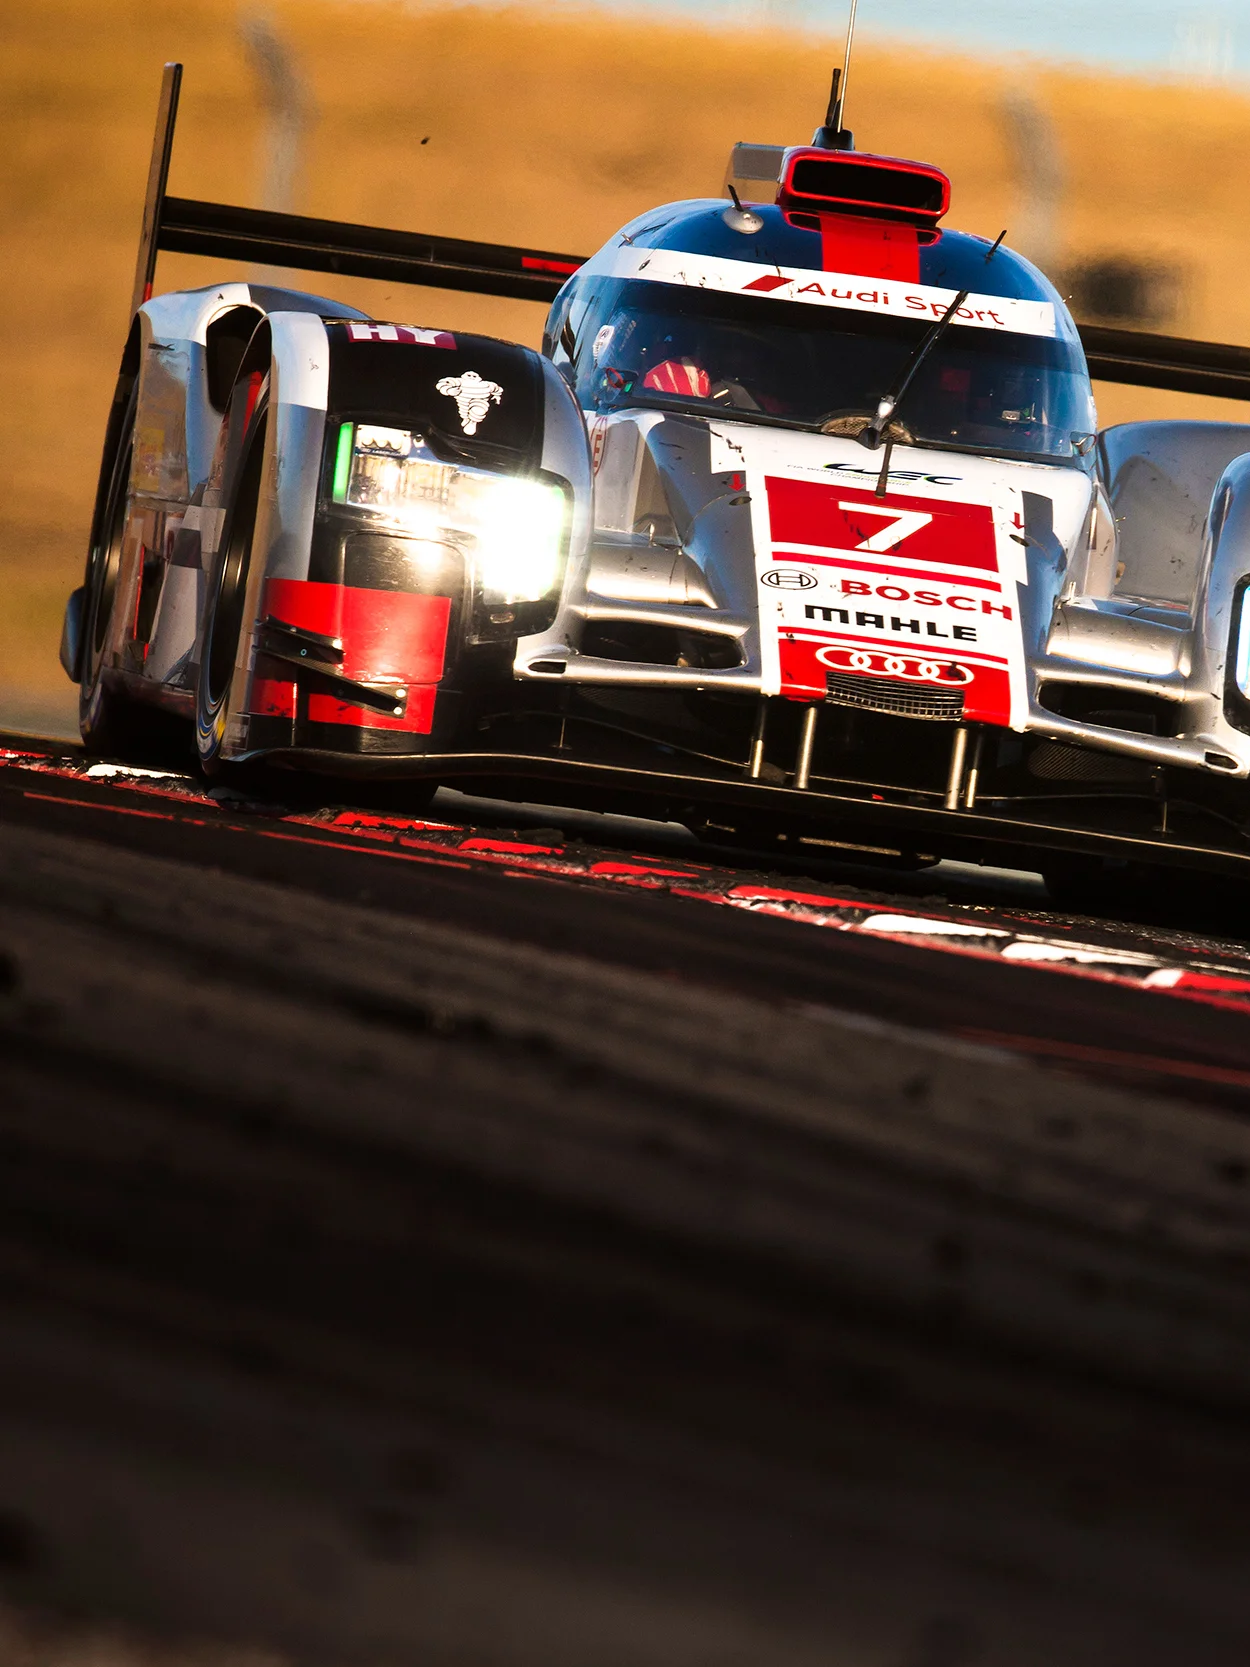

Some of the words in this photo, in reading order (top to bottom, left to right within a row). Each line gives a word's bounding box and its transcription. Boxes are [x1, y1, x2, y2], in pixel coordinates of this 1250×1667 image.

[798, 282, 890, 305] Audi
[904, 295, 1005, 325] Sport
[350, 324, 447, 345] HY
[839, 501, 933, 552] 7
[840, 579, 1013, 621] BOSCH
[804, 604, 978, 642] MAHLE
